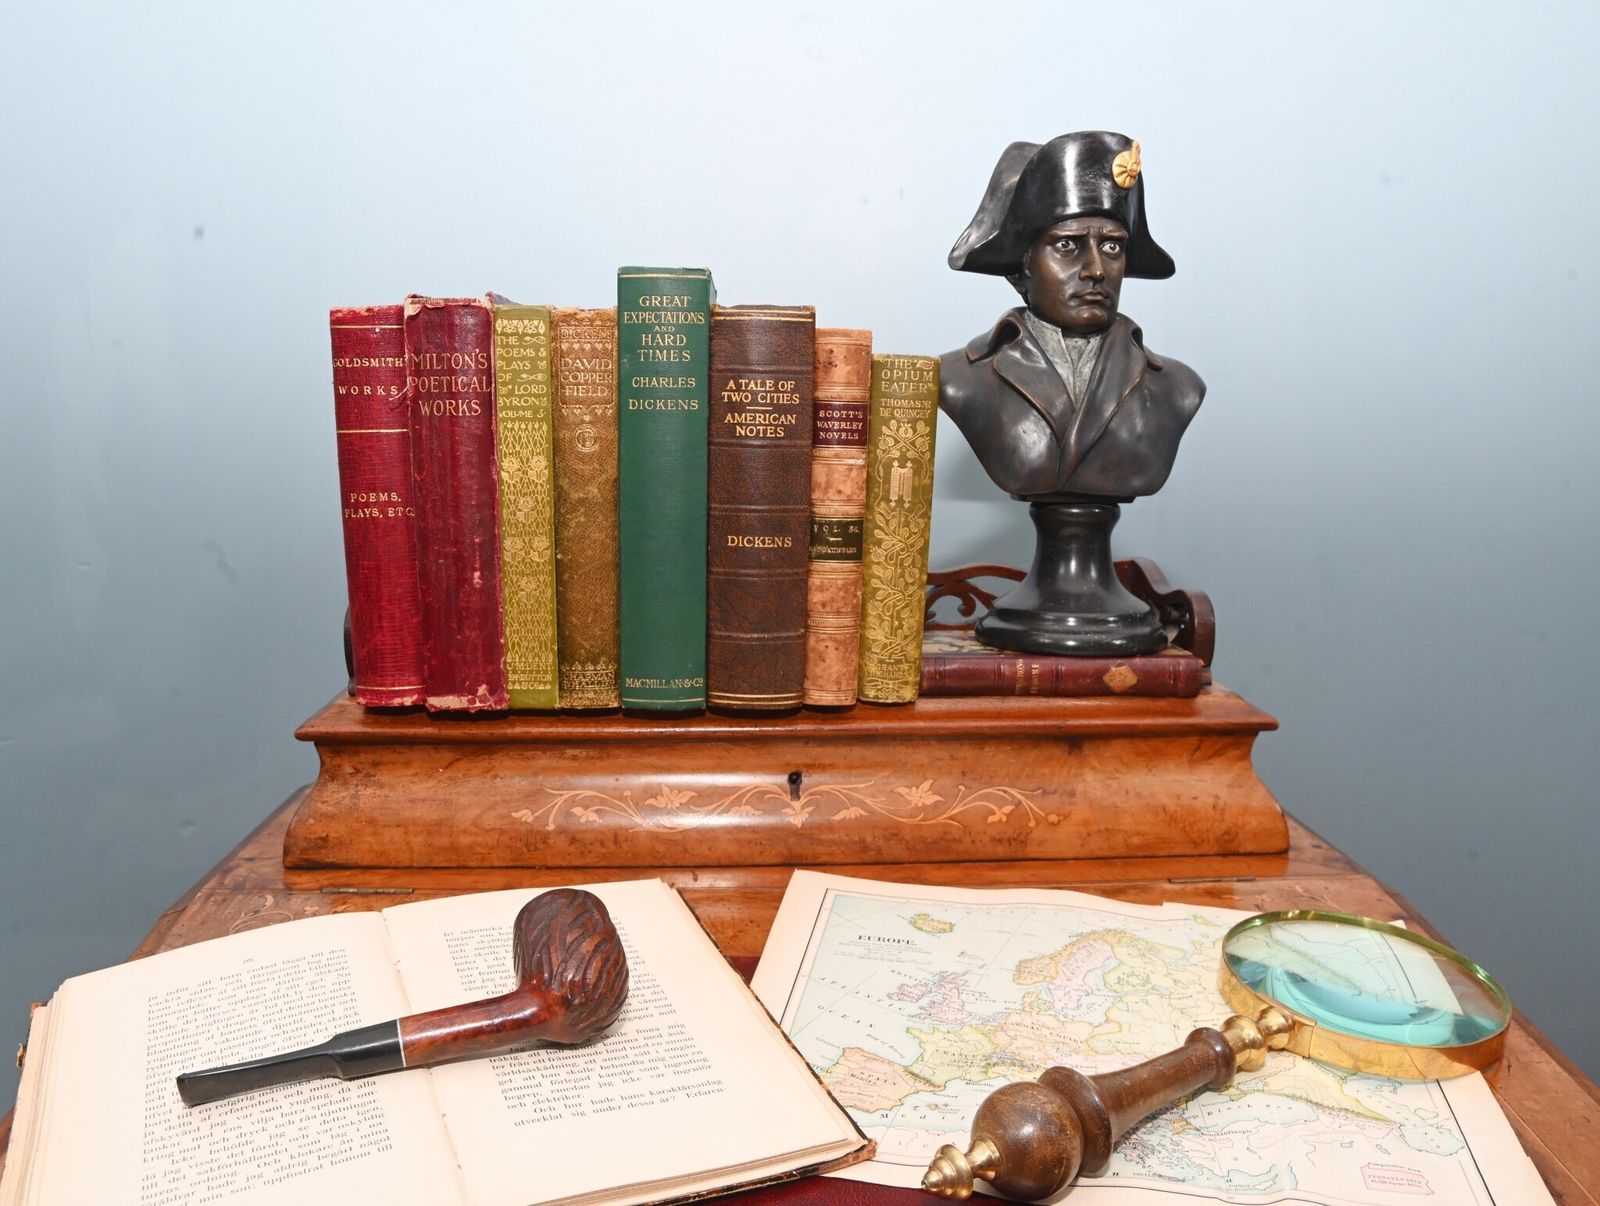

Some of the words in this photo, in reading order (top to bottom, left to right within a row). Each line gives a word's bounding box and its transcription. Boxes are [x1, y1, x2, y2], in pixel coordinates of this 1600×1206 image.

[640, 296, 691, 306] GREAT
[624, 312, 704, 324] EXPECTATIONS
[496, 336, 520, 345] THE
[642, 334, 686, 346] HARD
[496, 348, 535, 358] POEMS
[538, 348, 546, 357] &
[637, 350, 690, 362] TIMES
[410, 348, 488, 370] MILTON'S
[562, 358, 612, 370] DAVID
[496, 360, 530, 370] PLAYS
[498, 373, 512, 382] OF
[560, 372, 612, 382] COPPER
[882, 370, 934, 382] OPIUM
[409, 376, 490, 393] POETICAL
[632, 377, 696, 388] CHARLES
[726, 379, 737, 390] A
[740, 379, 774, 391] TALE
[778, 381, 796, 392] OF
[339, 386, 398, 396] WORKS
[515, 384, 546, 394] LORD
[498, 396, 540, 406] BYRON
[722, 392, 751, 403] TWO
[758, 392, 800, 404] CITIES
[880, 398, 921, 408] THOMAS
[419, 400, 482, 416] WORKS
[628, 399, 698, 410] DICKENS
[498, 410, 532, 418] VOLUME
[819, 410, 863, 418] SCOTT'S
[880, 408, 891, 416] DE
[894, 408, 930, 418] QUINCEY
[724, 413, 796, 425] AMERICAN
[816, 420, 863, 430] WAVERLEY
[736, 426, 784, 437] NOTES
[819, 432, 859, 440] NOVELS
[728, 536, 792, 548] DICKENS
